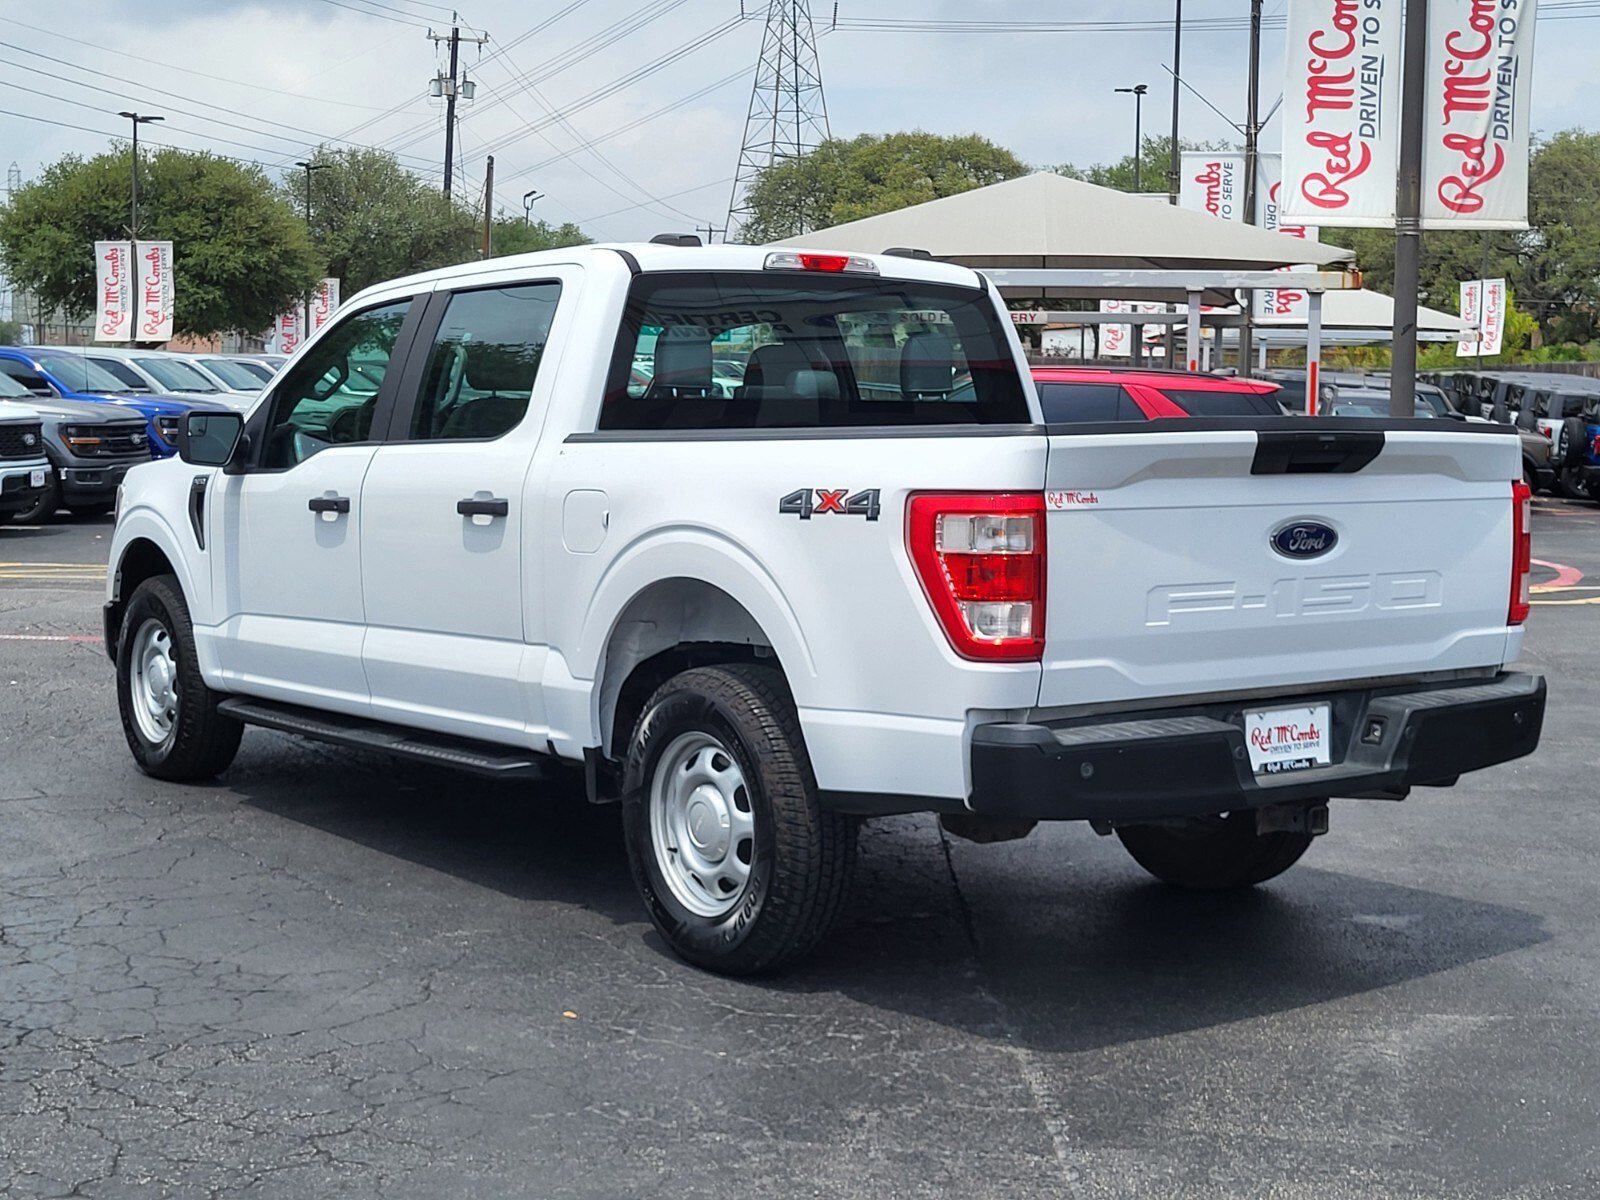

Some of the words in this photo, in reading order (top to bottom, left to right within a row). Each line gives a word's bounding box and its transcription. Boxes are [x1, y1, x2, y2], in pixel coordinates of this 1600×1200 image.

[1362, 17, 1380, 47] TO
[1498, 18, 1516, 48] TO
[1359, 55, 1379, 139] DRIVEN
[1493, 55, 1513, 140] DRIVEN
[1195, 162, 1222, 217] ombs
[1223, 162, 1234, 201] SERVE
[1301, 131, 1371, 209] Red
[1438, 133, 1505, 213] Red
[104, 247, 119, 307] McCombs
[145, 247, 160, 307] McCombs
[102, 309, 124, 335] Red
[143, 309, 166, 335] Red
[900, 313, 936, 323] SOLD
[1010, 313, 1037, 323] ERY
[1048, 491, 1064, 508] Red
[1289, 527, 1325, 550] Ford
[1145, 570, 1443, 626] F-150
[1251, 727, 1273, 752] Red
[1274, 722, 1320, 744] McCombs
